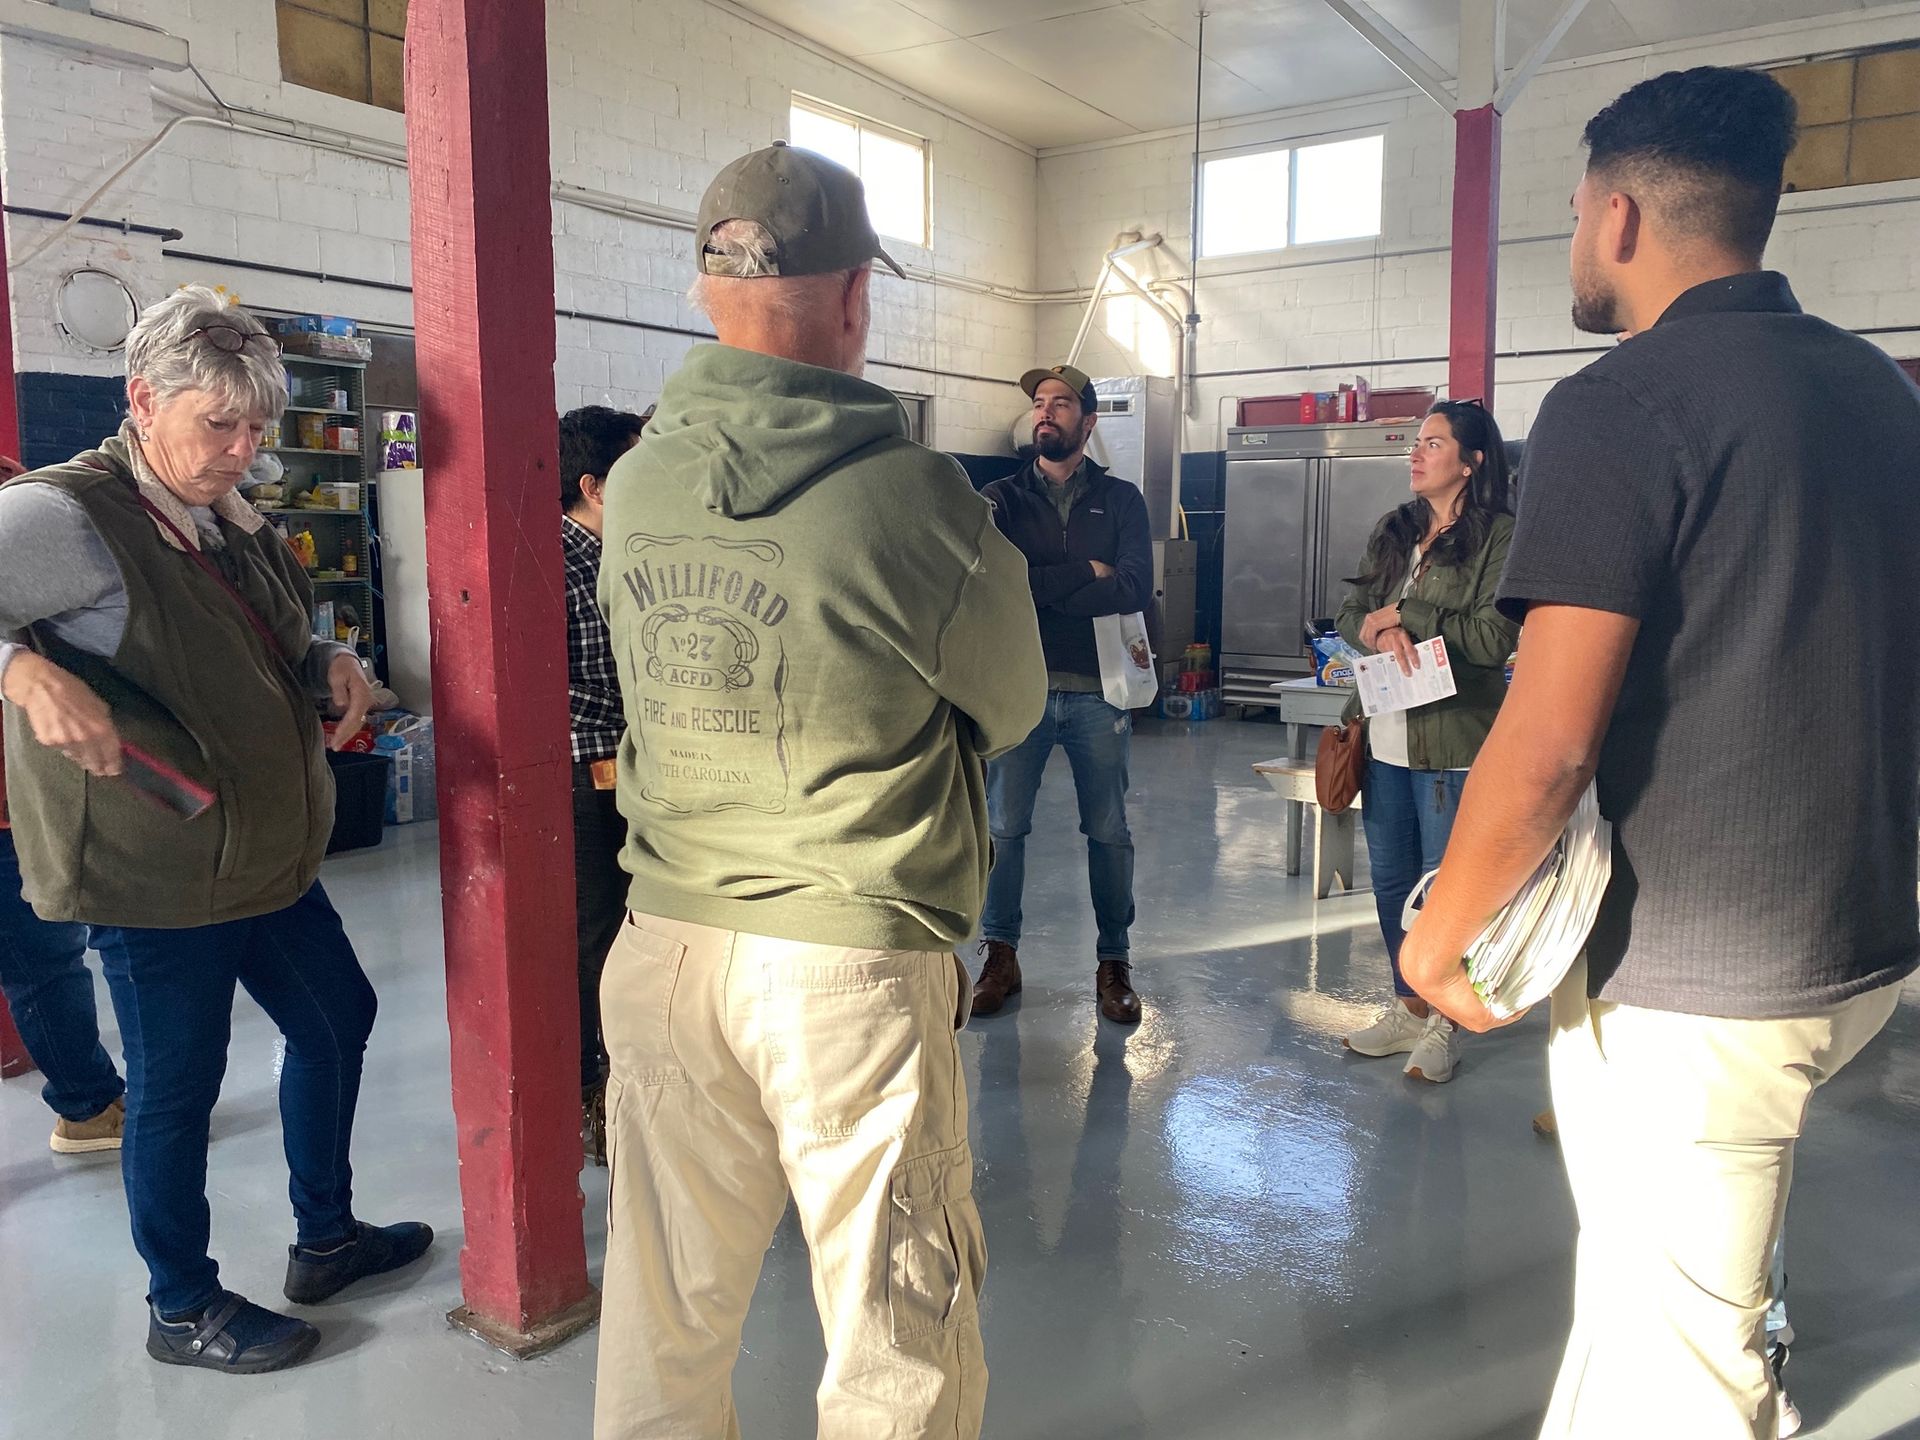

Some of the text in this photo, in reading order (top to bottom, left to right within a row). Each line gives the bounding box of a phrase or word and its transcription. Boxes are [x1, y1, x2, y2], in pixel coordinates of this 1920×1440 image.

[670, 668, 713, 687] ACFD
[644, 698, 761, 734] FIRE AND RESCUE
[669, 749, 699, 760] MADE
[682, 765, 752, 784] CAROLINA
